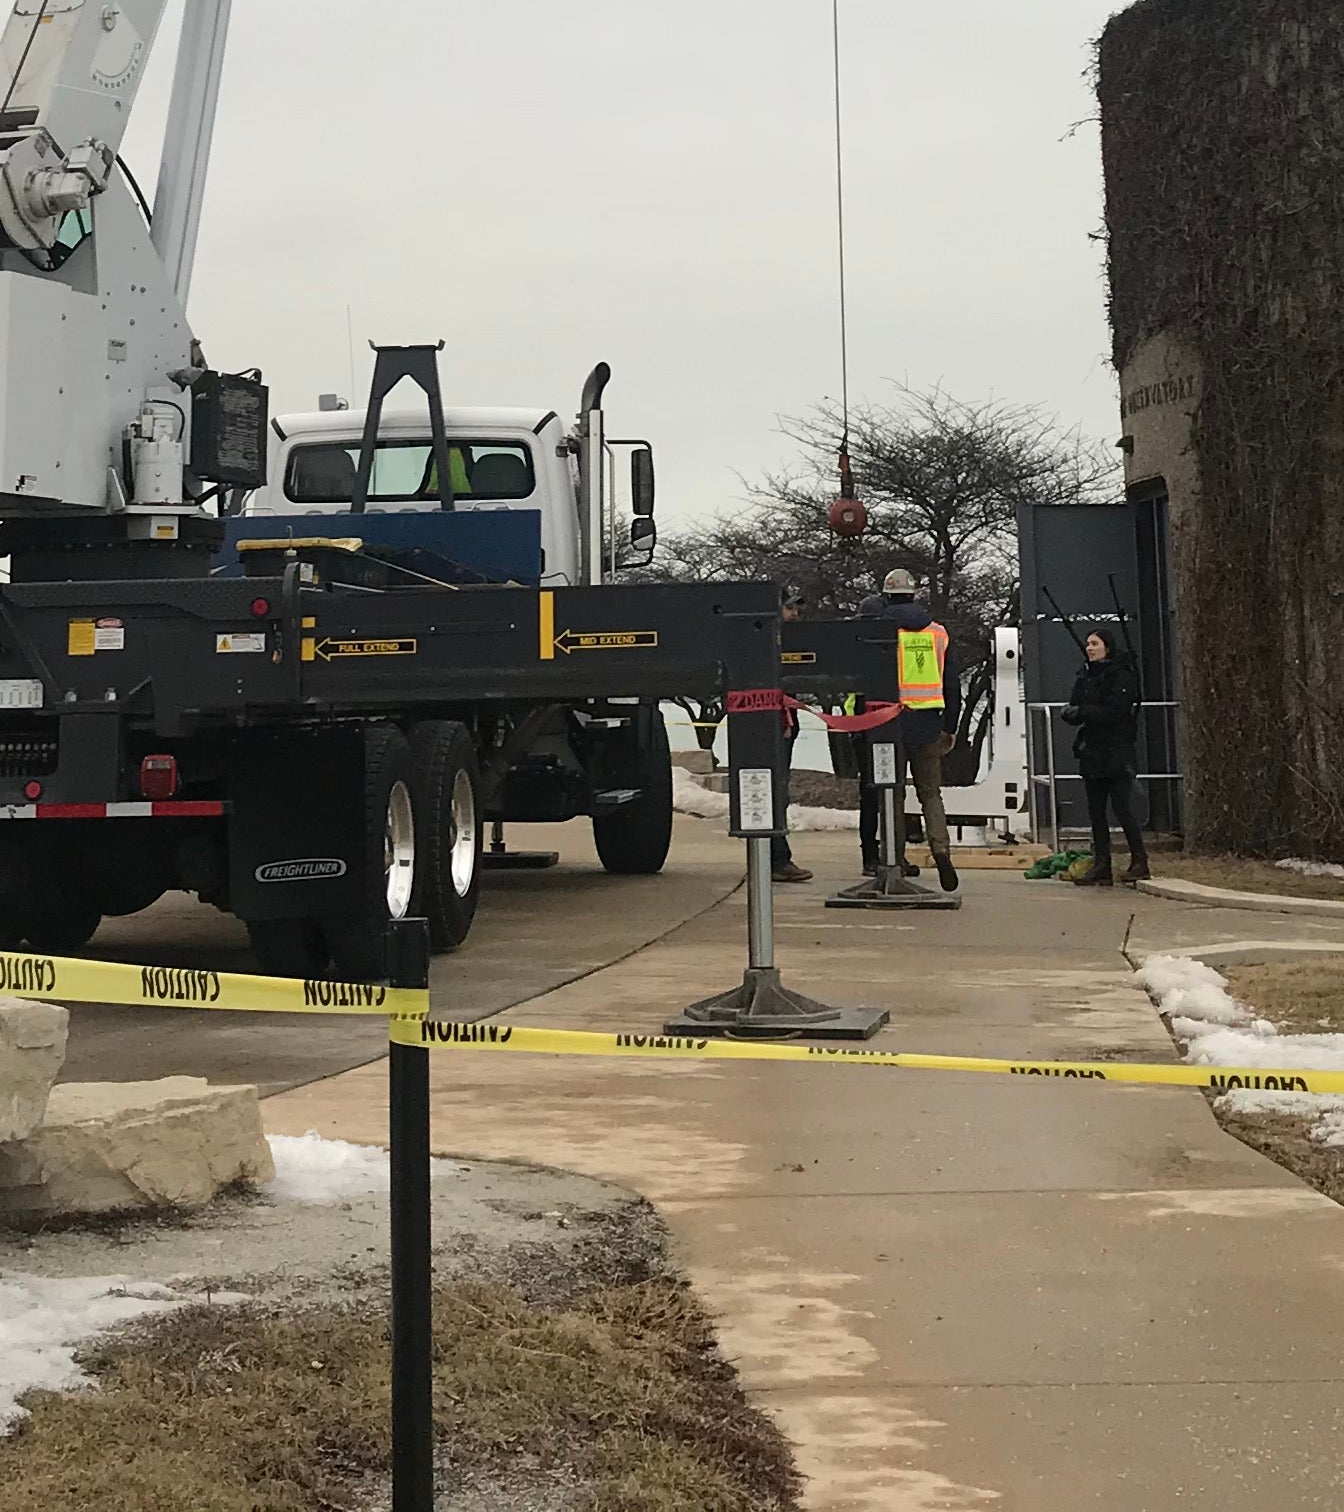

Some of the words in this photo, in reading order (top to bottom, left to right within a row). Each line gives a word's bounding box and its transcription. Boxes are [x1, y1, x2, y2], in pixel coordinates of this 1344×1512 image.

[579, 636, 597, 645] MID
[599, 635, 636, 645] EXTEND
[338, 643, 361, 652] FULL
[363, 642, 400, 651] EXTEND
[264, 862, 339, 878] FREIGHTLINER
[141, 967, 220, 1002] CAUTION
